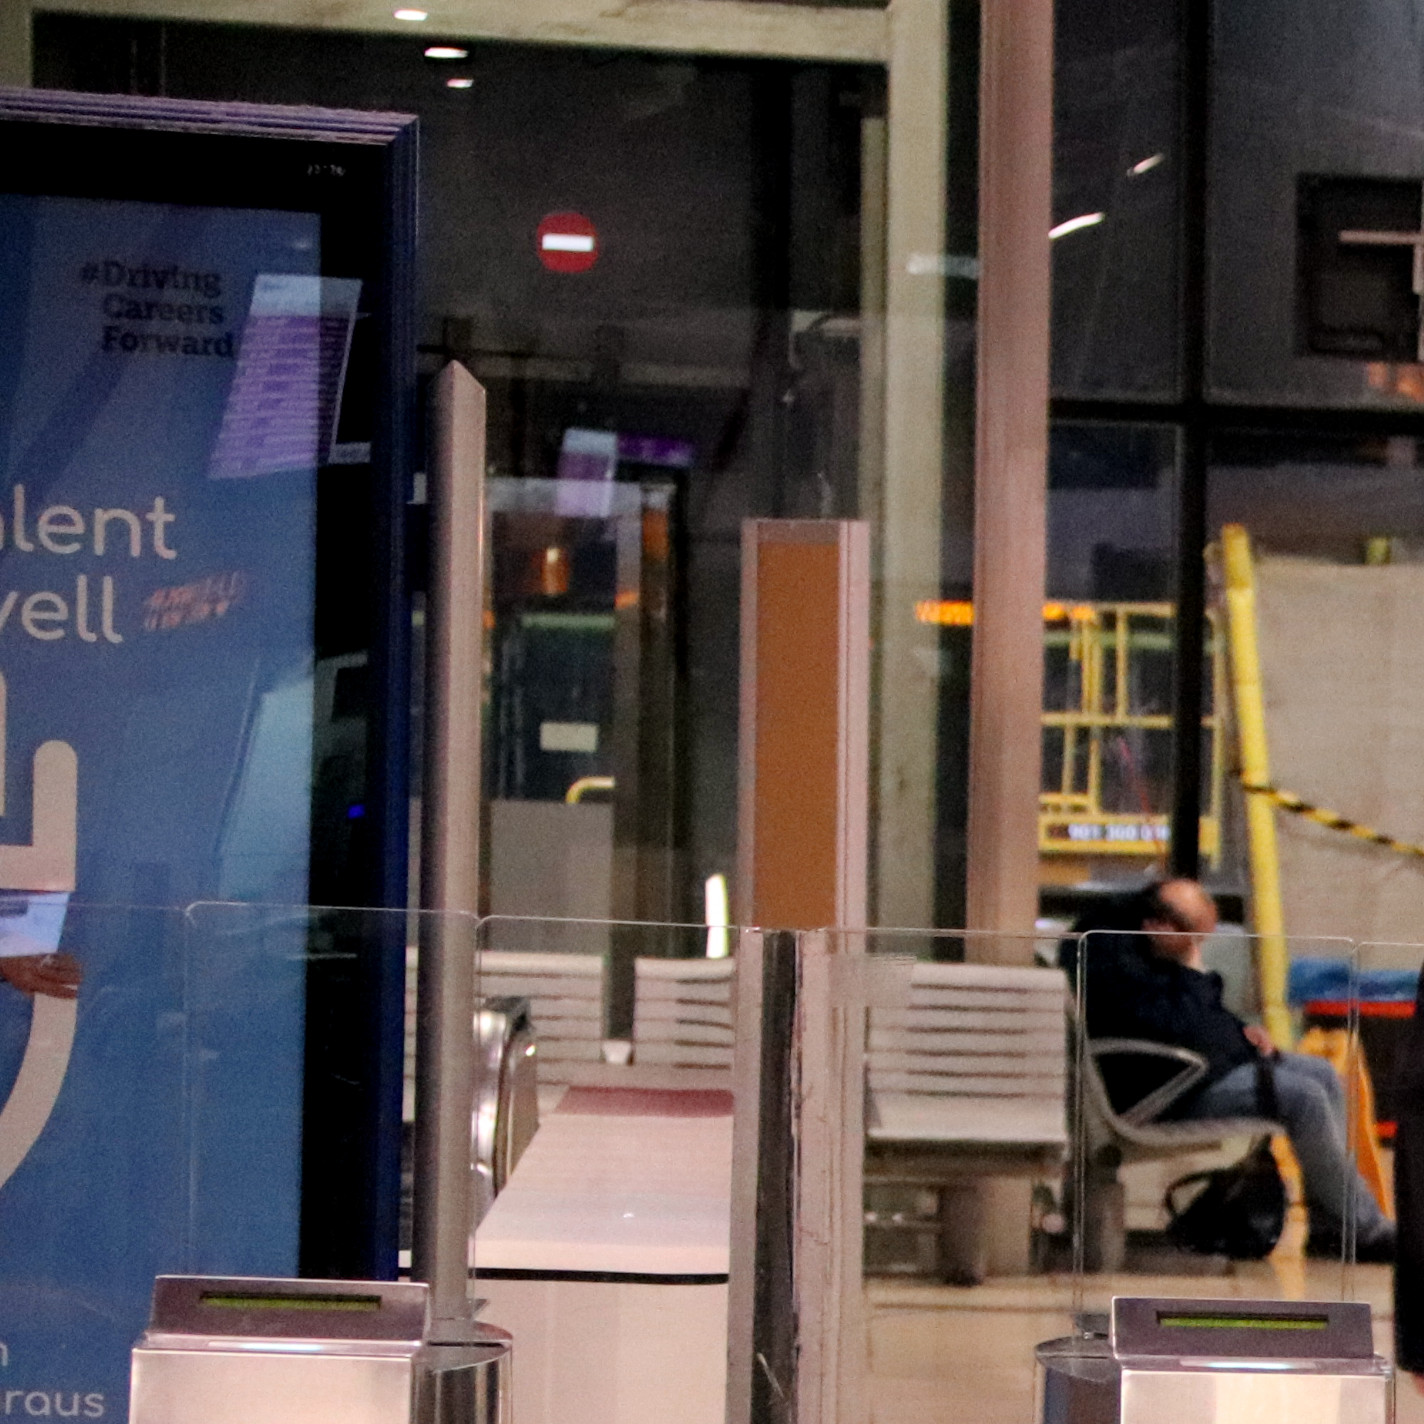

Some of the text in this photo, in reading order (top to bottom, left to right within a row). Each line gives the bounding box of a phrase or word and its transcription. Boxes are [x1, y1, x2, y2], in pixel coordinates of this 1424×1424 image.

[80, 259, 221, 299] #Driving
[103, 293, 224, 324] Careers
[102, 325, 234, 358] Forward
[0, 484, 178, 560] lent
[5, 1389, 105, 1418] raus
